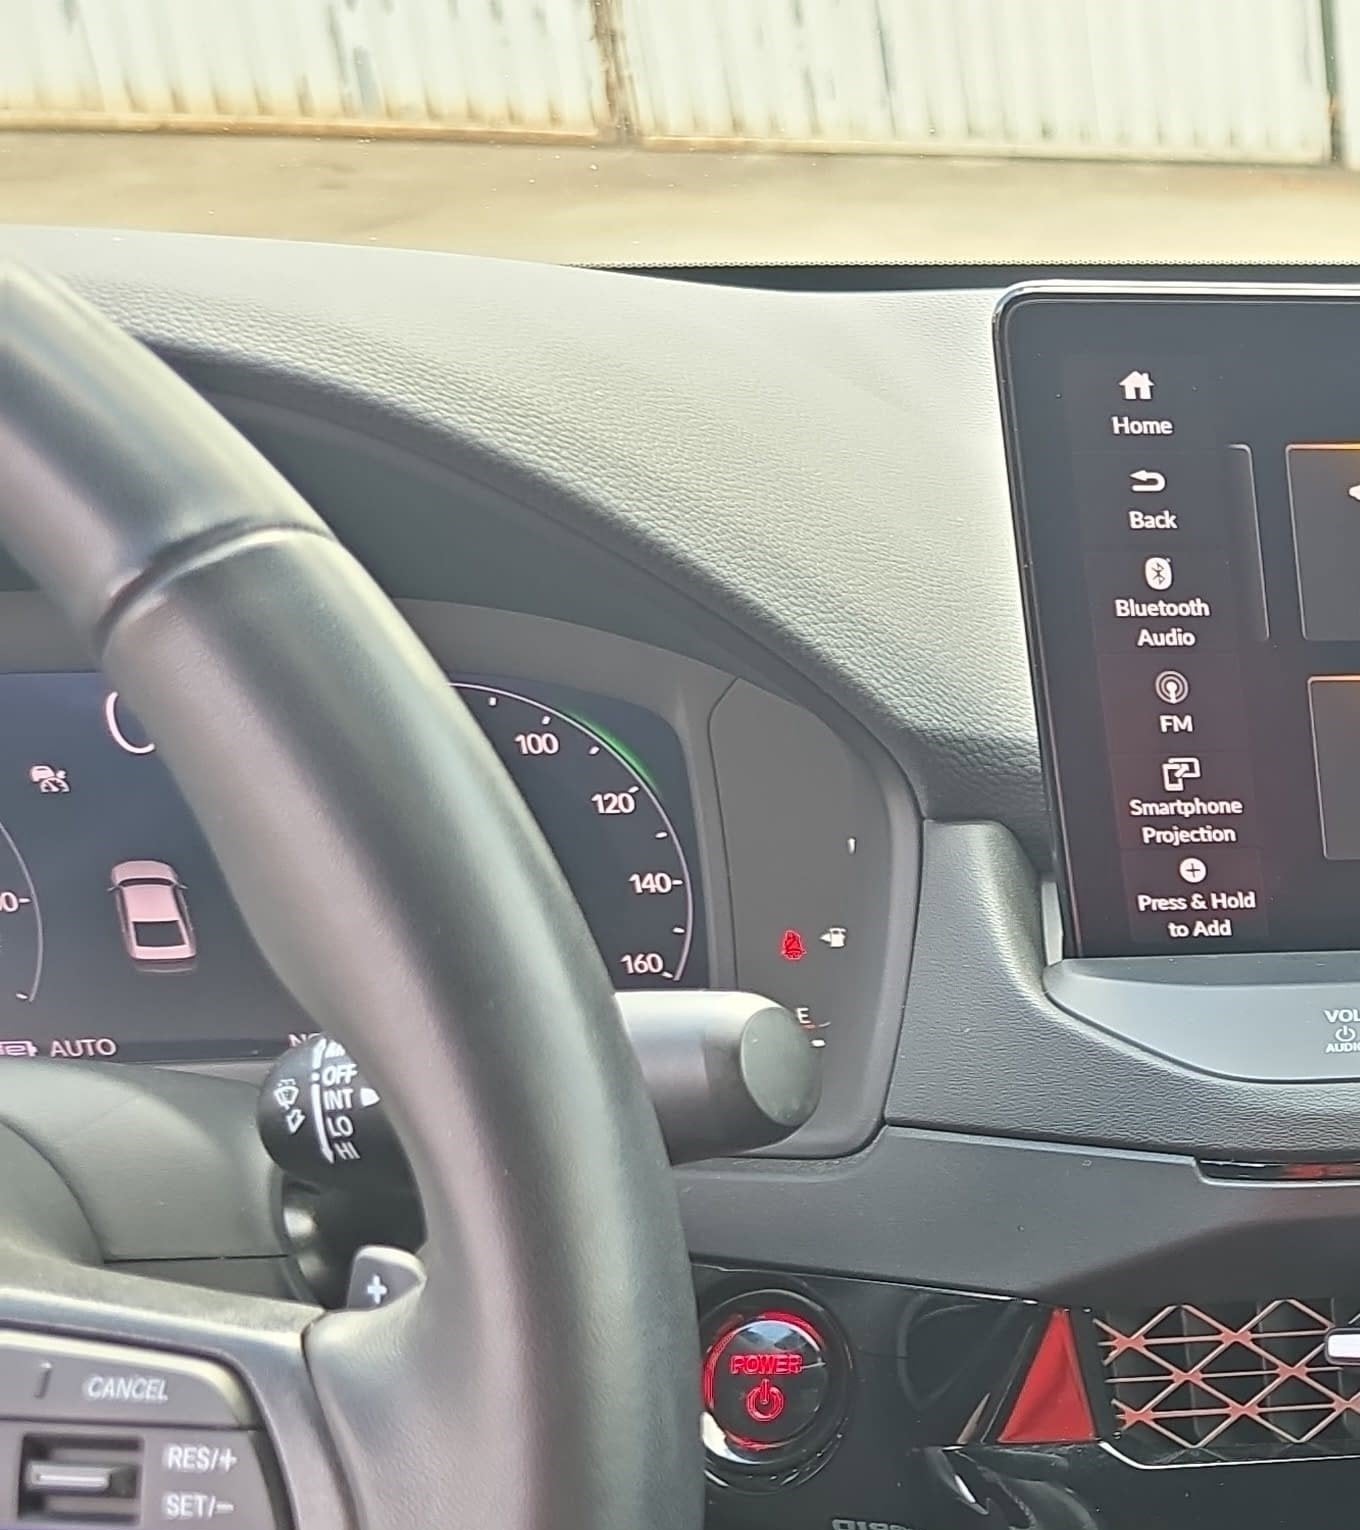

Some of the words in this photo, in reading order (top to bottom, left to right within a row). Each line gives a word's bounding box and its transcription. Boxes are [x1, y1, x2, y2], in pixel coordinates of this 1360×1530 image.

[1111, 416, 1173, 435] Home
[1128, 510, 1178, 529] Back
[1115, 597, 1210, 617] Bluetooth
[1137, 627, 1196, 646] Audio
[1159, 714, 1193, 733] FM
[515, 733, 559, 755] 100
[591, 792, 635, 814] 120
[1129, 797, 1243, 818] Smartphone
[1141, 824, 1237, 846] Projection
[629, 872, 672, 893] 140
[1137, 894, 1188, 912] Press
[1190, 893, 1208, 910] &
[1210, 891, 1256, 909] Hold
[1167, 922, 1190, 938] to
[1192, 918, 1232, 937] Add
[620, 953, 664, 974] 160
[51, 1038, 117, 1057] AUTO
[322, 1063, 359, 1086] OFF
[323, 1089, 353, 1110] INT
[326, 1115, 353, 1137] LO
[334, 1141, 360, 1160] HI
[730, 1354, 803, 1375] POWER
[86, 1376, 168, 1400] CANCEL
[165, 1447, 237, 1472] RES/+
